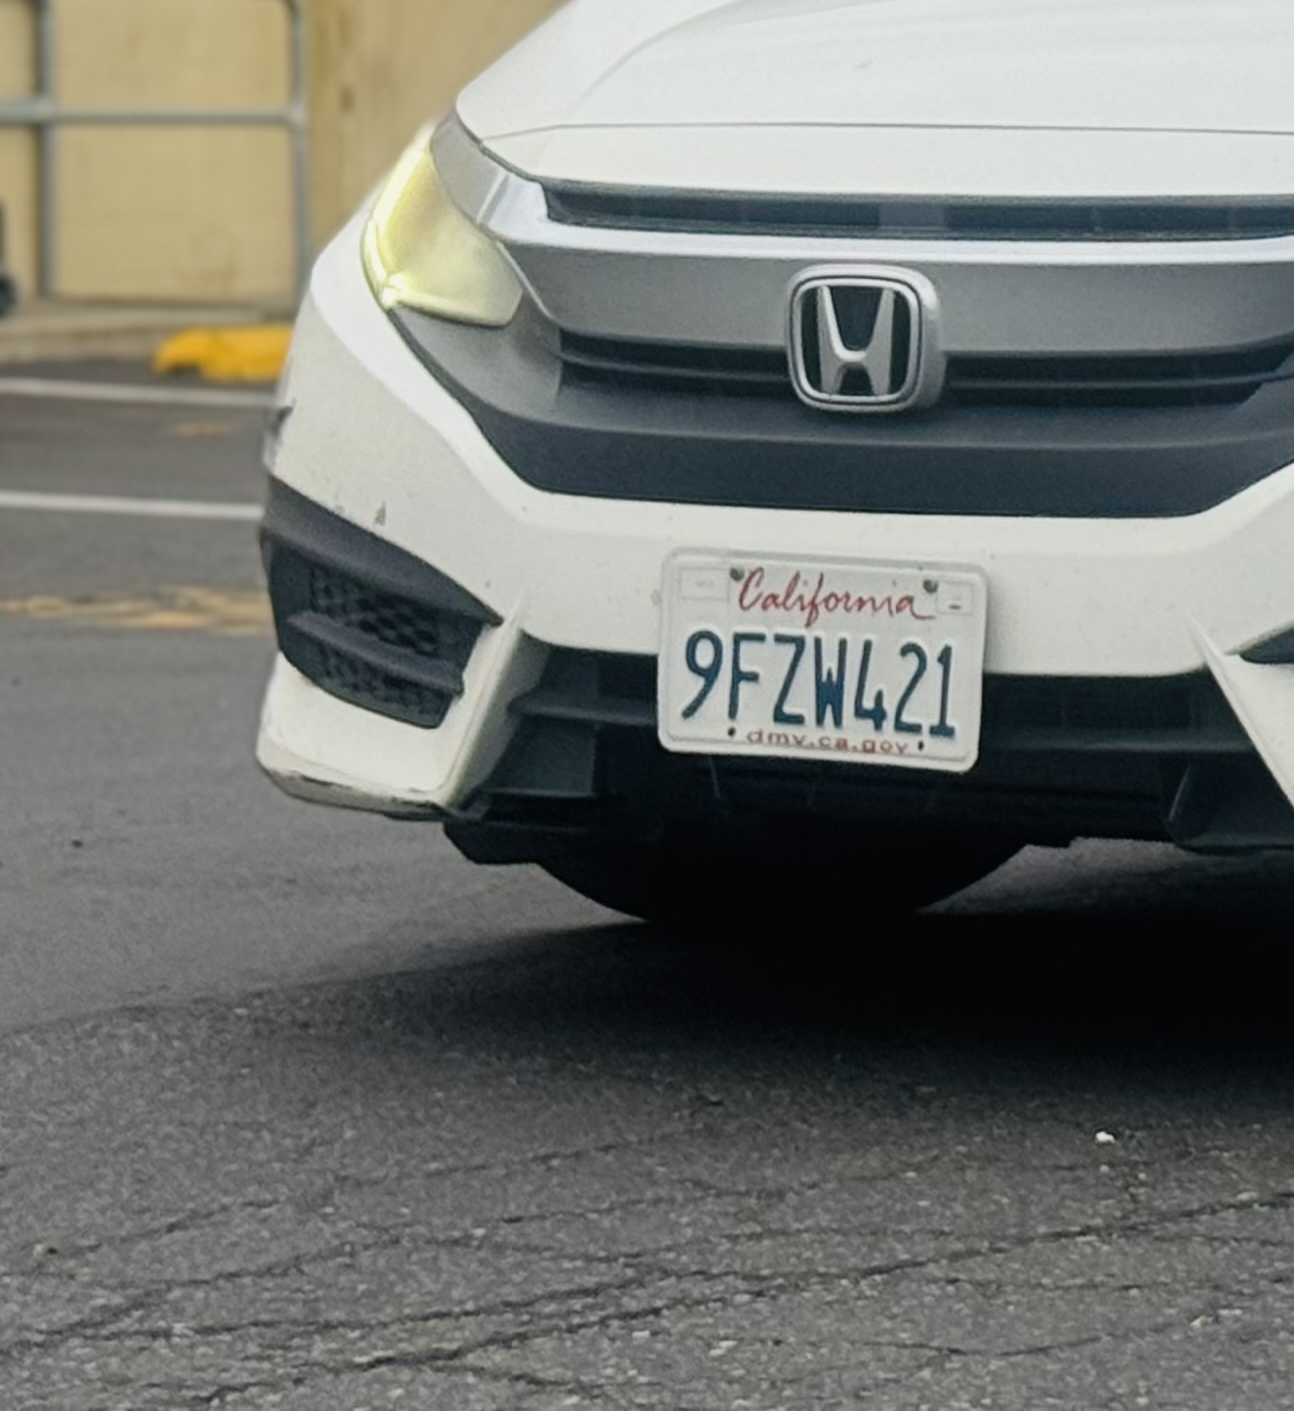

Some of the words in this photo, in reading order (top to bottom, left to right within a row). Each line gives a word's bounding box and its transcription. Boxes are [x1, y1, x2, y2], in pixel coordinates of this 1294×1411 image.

[738, 566, 936, 627] California
[681, 629, 956, 739] 9FZW421
[746, 729, 908, 754] dmv.ca.gov
